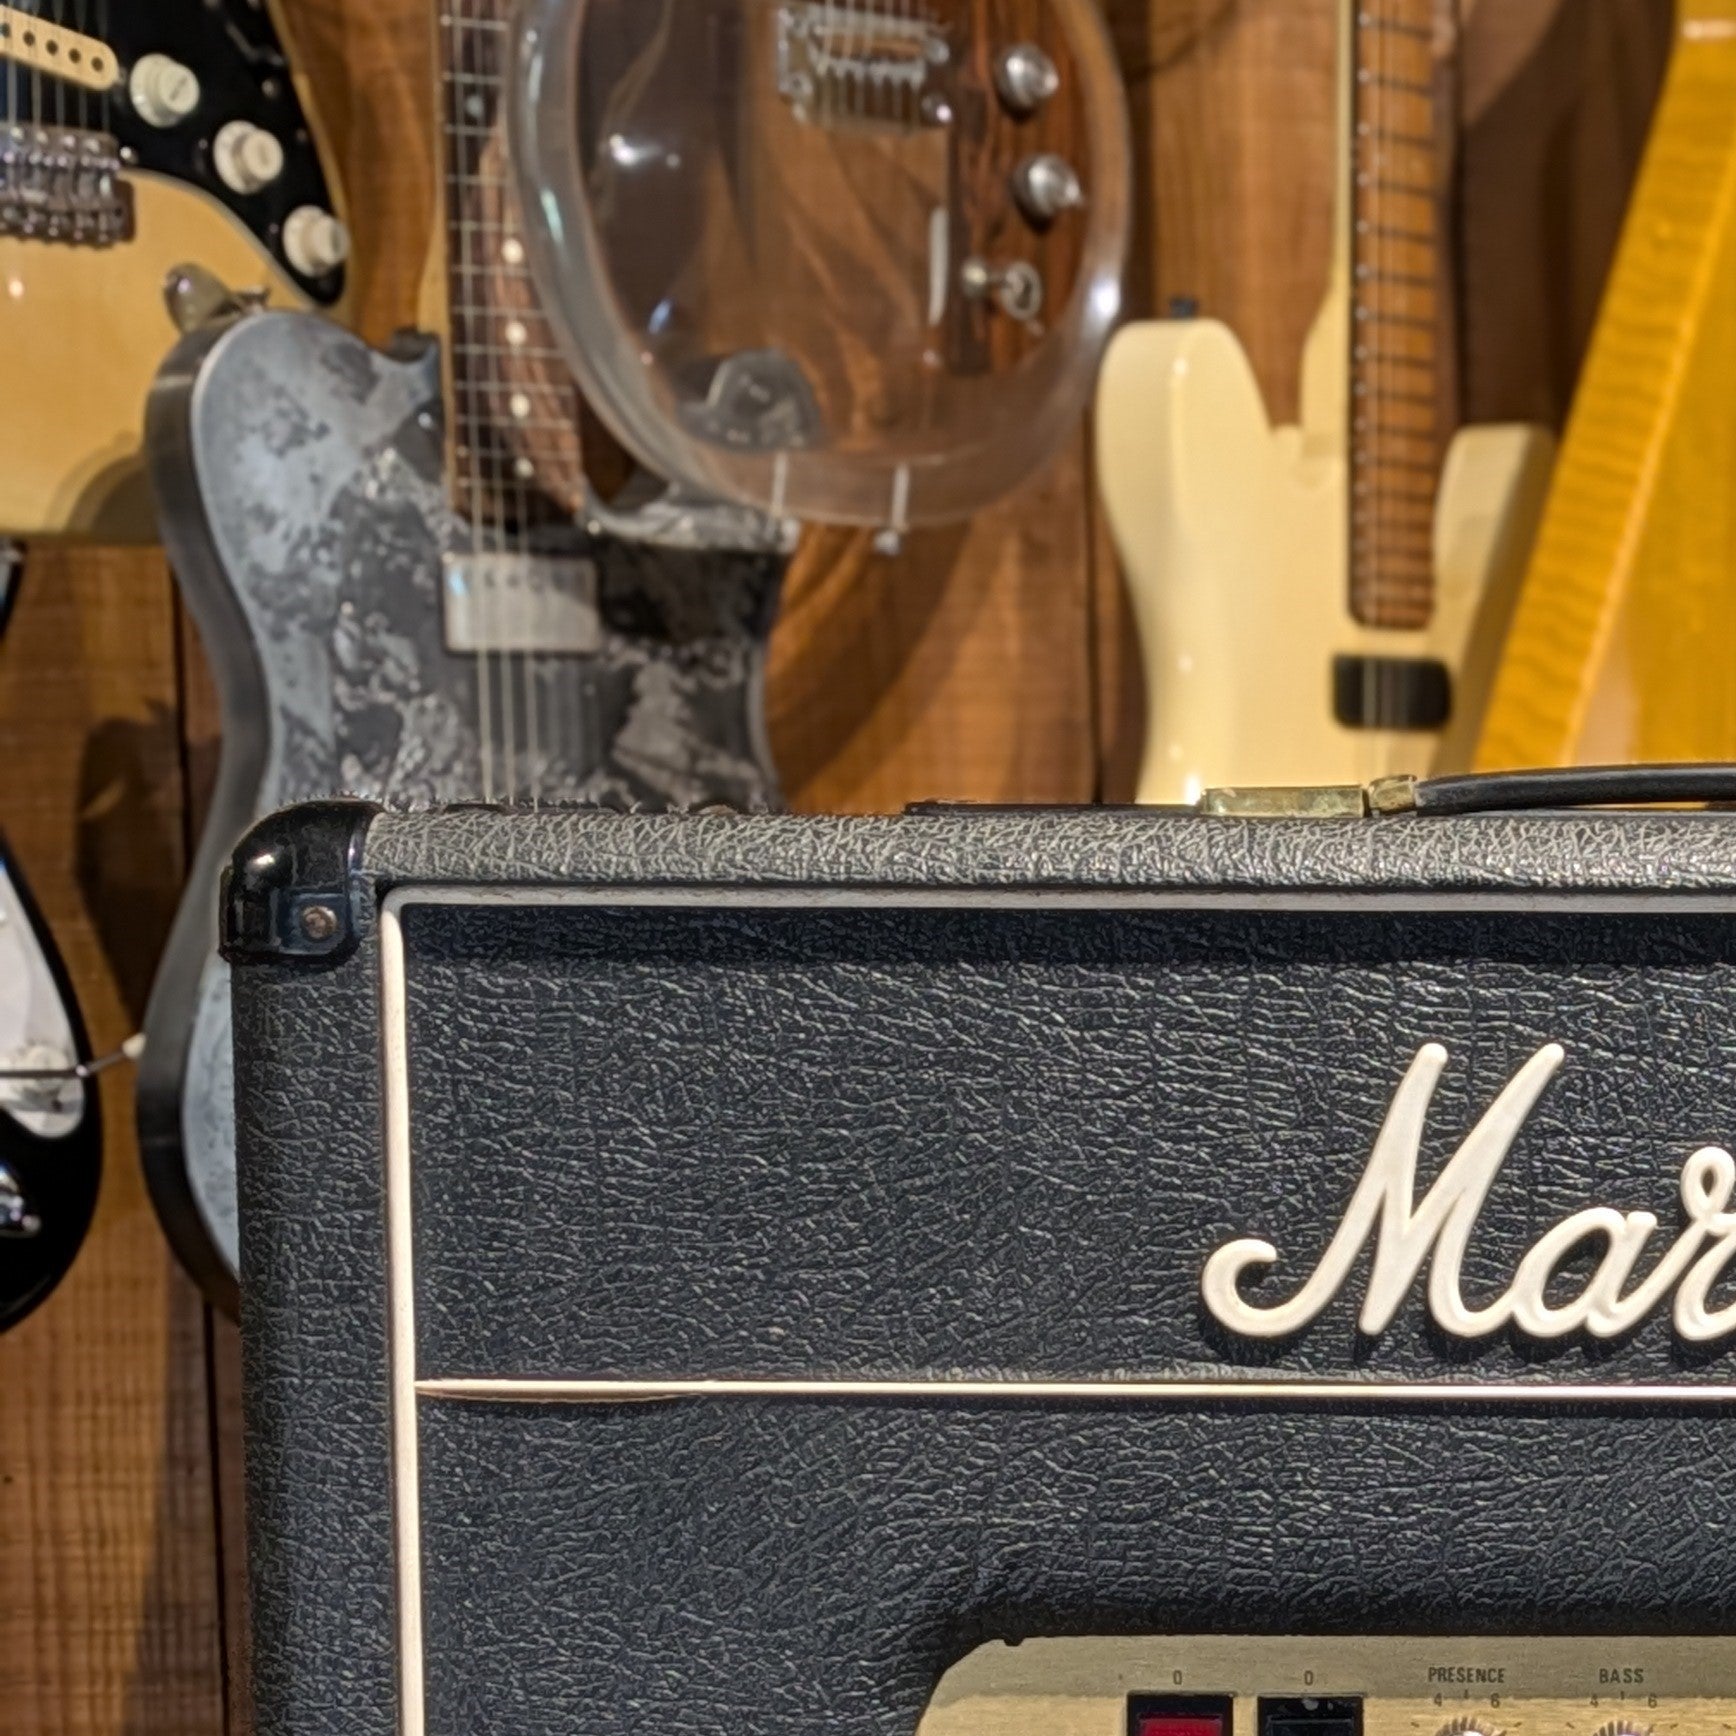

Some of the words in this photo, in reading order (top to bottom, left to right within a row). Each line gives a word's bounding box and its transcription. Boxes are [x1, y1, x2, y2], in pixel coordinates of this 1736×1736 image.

[1427, 1667, 1505, 1683] PRESENCE
[1599, 1668, 1645, 1684] BASS
[1491, 1692, 1500, 1708] 6
[1648, 1693, 1657, 1709] 6
